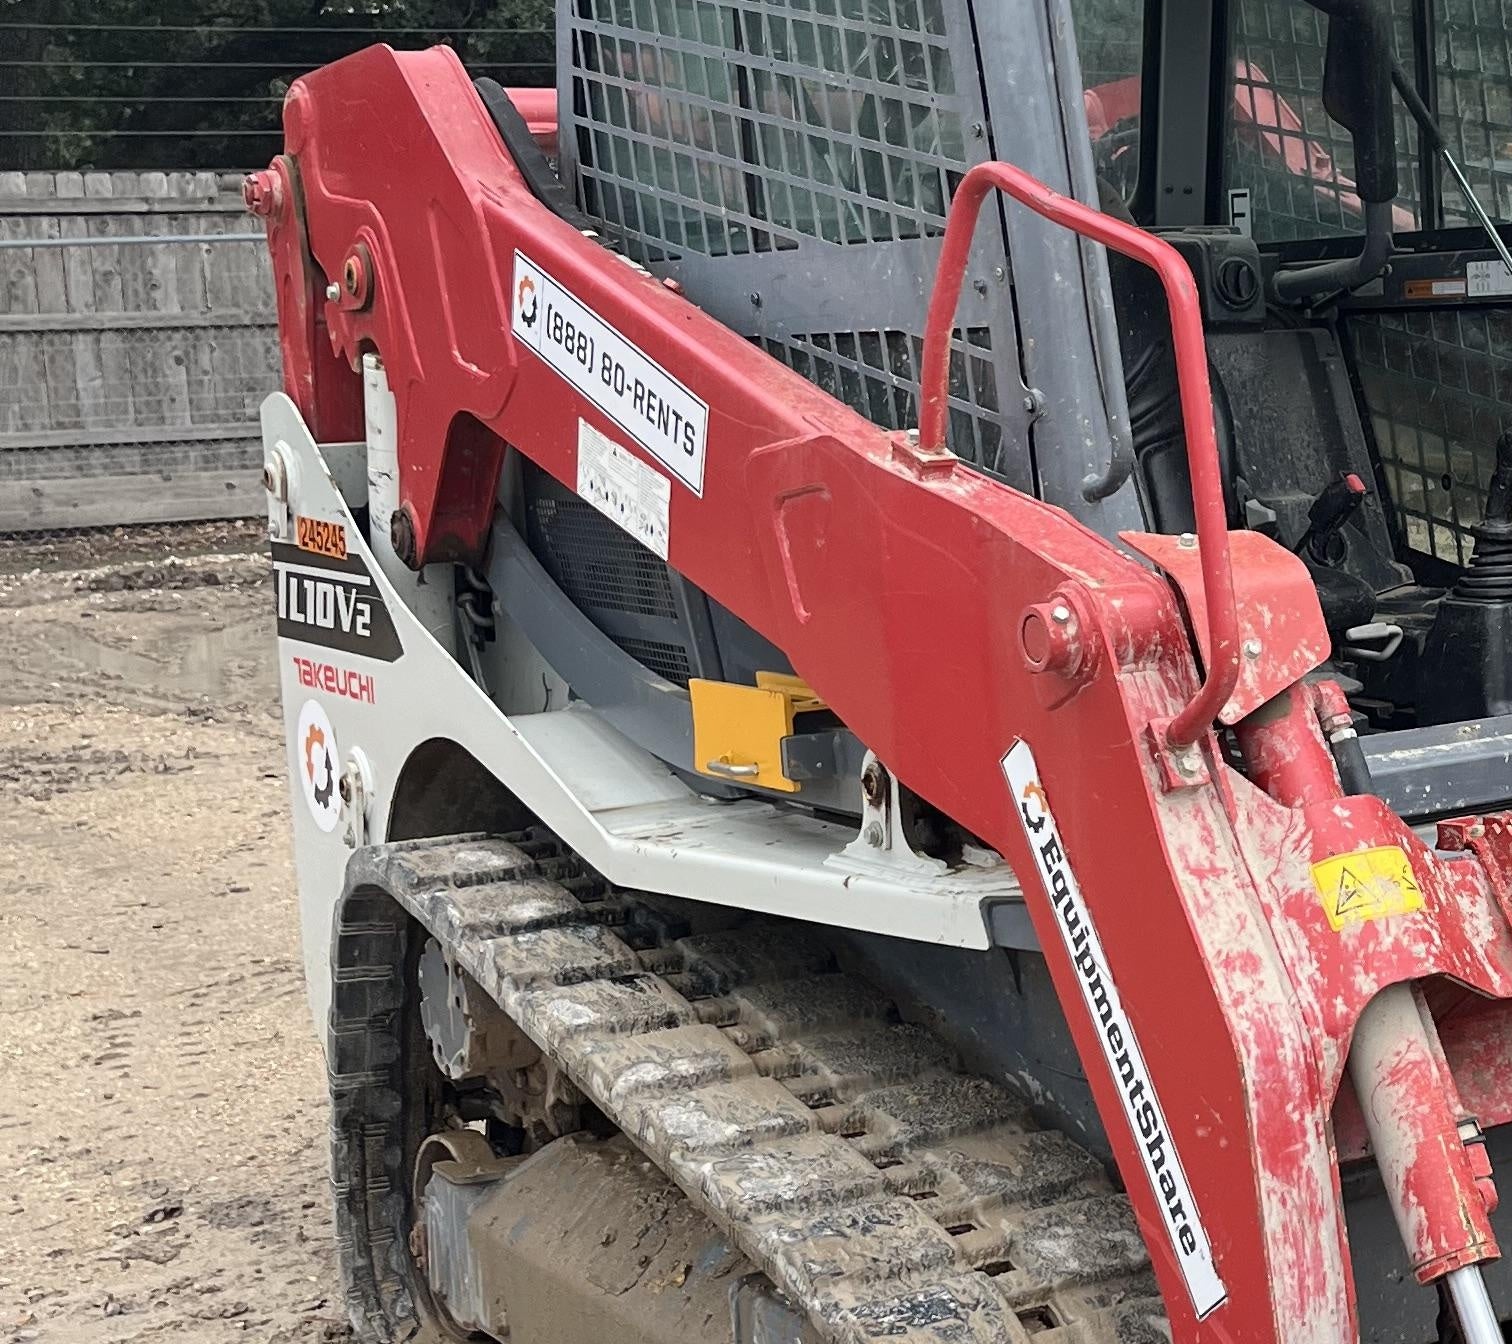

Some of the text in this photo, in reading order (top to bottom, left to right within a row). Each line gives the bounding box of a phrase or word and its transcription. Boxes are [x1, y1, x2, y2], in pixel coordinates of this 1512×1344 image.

[546, 303, 696, 457] (888) 80-RENTS
[300, 517, 346, 557] 245245
[1040, 832, 1197, 1257] EquipmentShare
